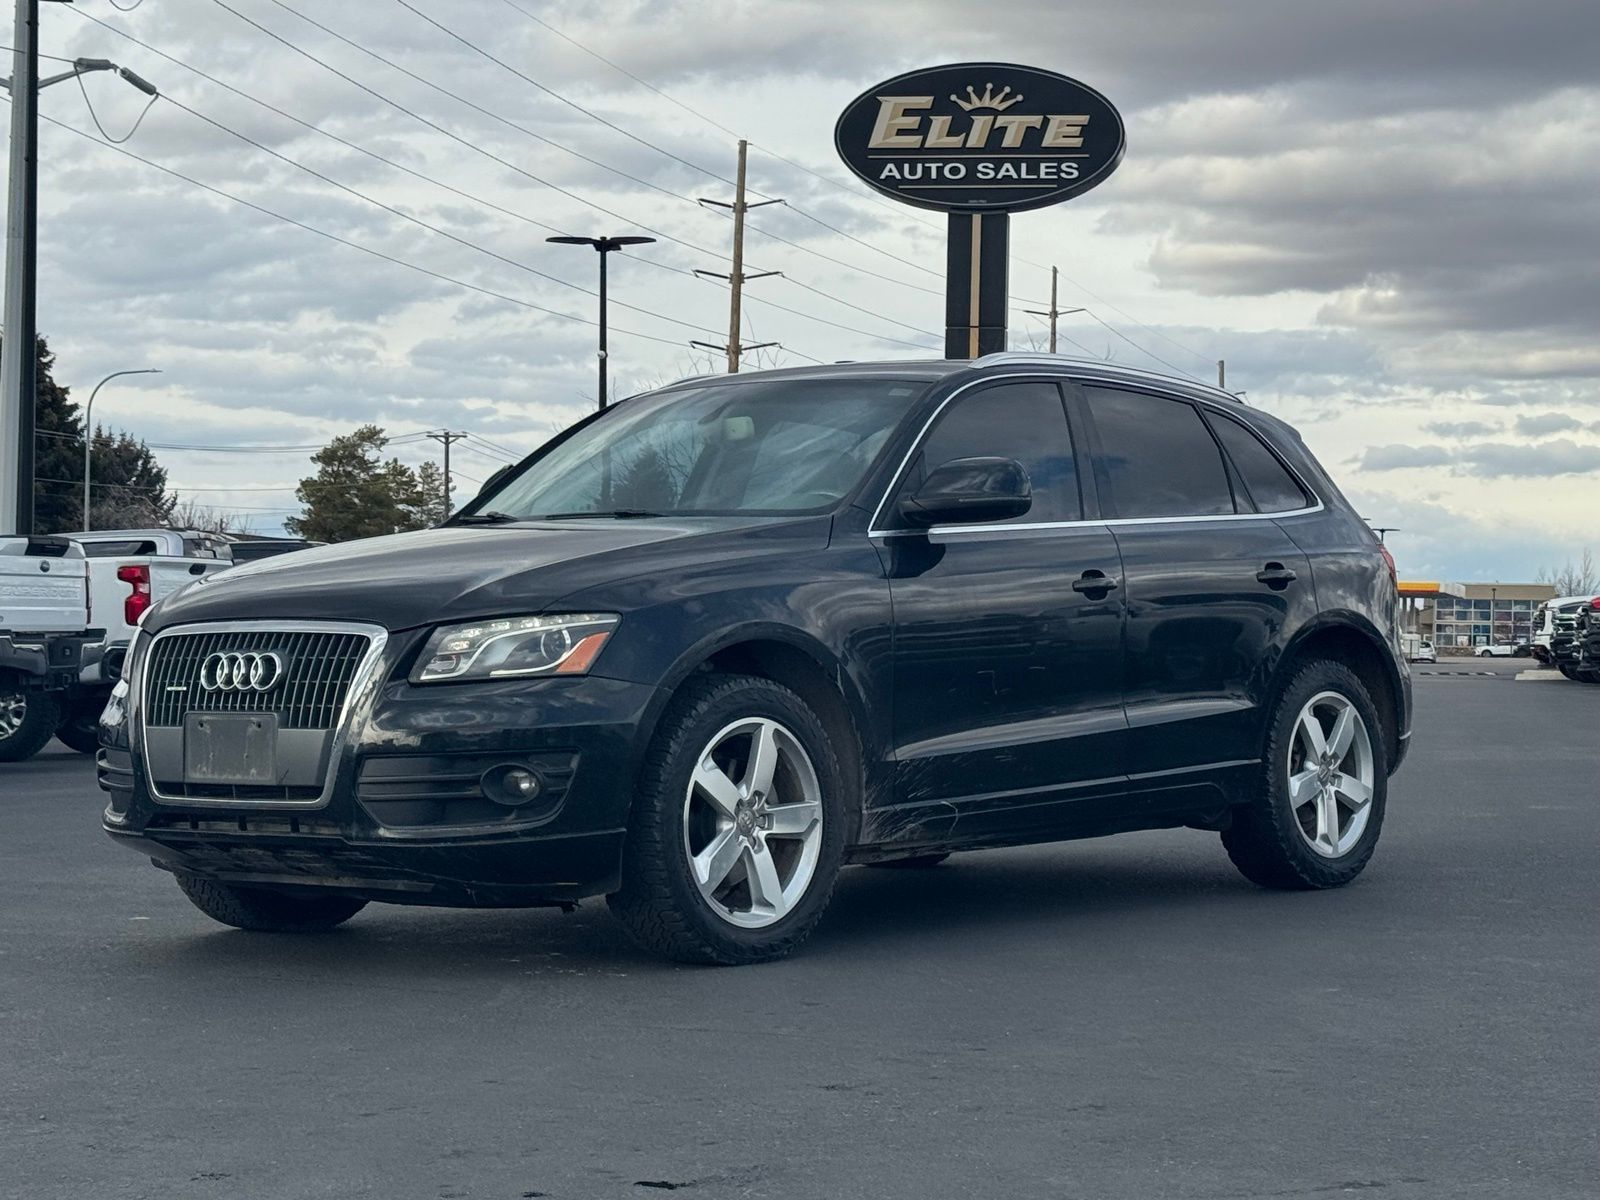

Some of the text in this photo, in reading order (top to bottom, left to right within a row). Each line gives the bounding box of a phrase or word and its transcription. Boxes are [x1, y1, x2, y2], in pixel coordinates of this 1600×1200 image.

[867, 96, 1090, 149] ELITE
[879, 162, 1080, 180] AUTO SALES
